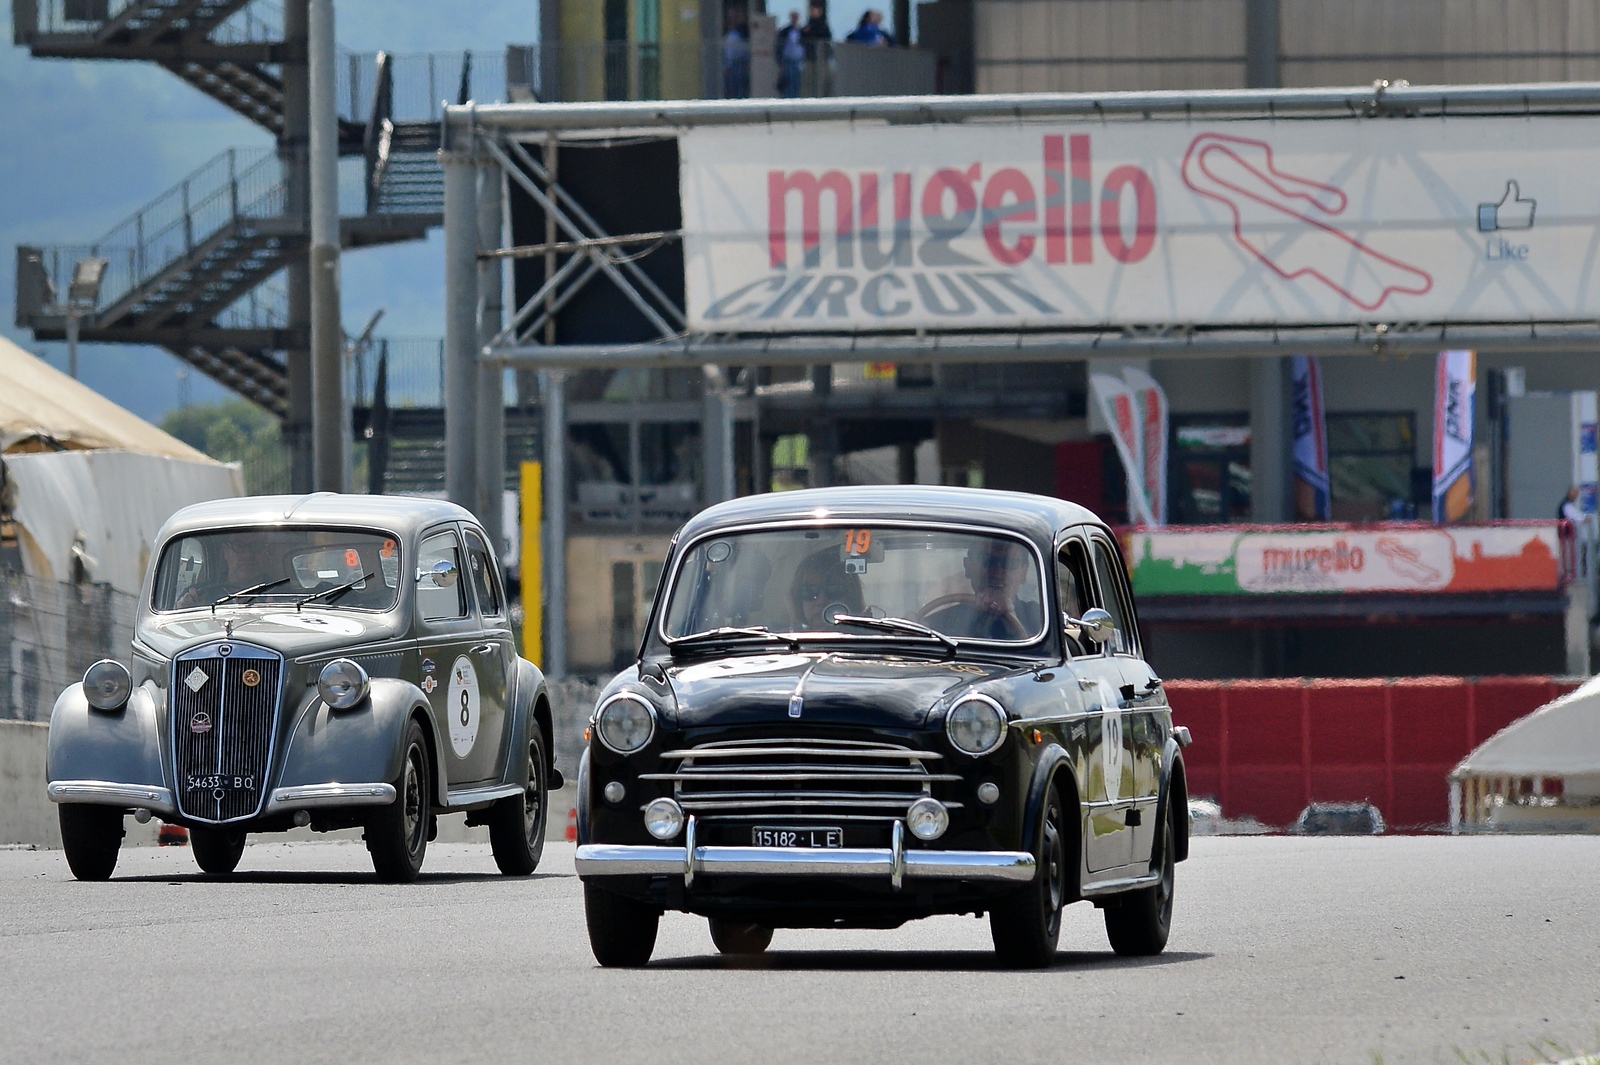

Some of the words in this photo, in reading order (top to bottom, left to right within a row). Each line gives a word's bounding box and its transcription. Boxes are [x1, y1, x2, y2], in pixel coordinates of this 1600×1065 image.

[766, 133, 1158, 268] mugello
[1485, 238, 1530, 262] Like
[702, 272, 1063, 319] CIRCUIT
[381, 539, 396, 558] 8
[845, 529, 871, 554] 19
[345, 551, 359, 568] 8
[460, 689, 470, 727] 8
[1107, 718, 1119, 766] 19
[189, 776, 219, 789] 54633
[234, 777, 253, 788] BO
[757, 831, 796, 846] 15182
